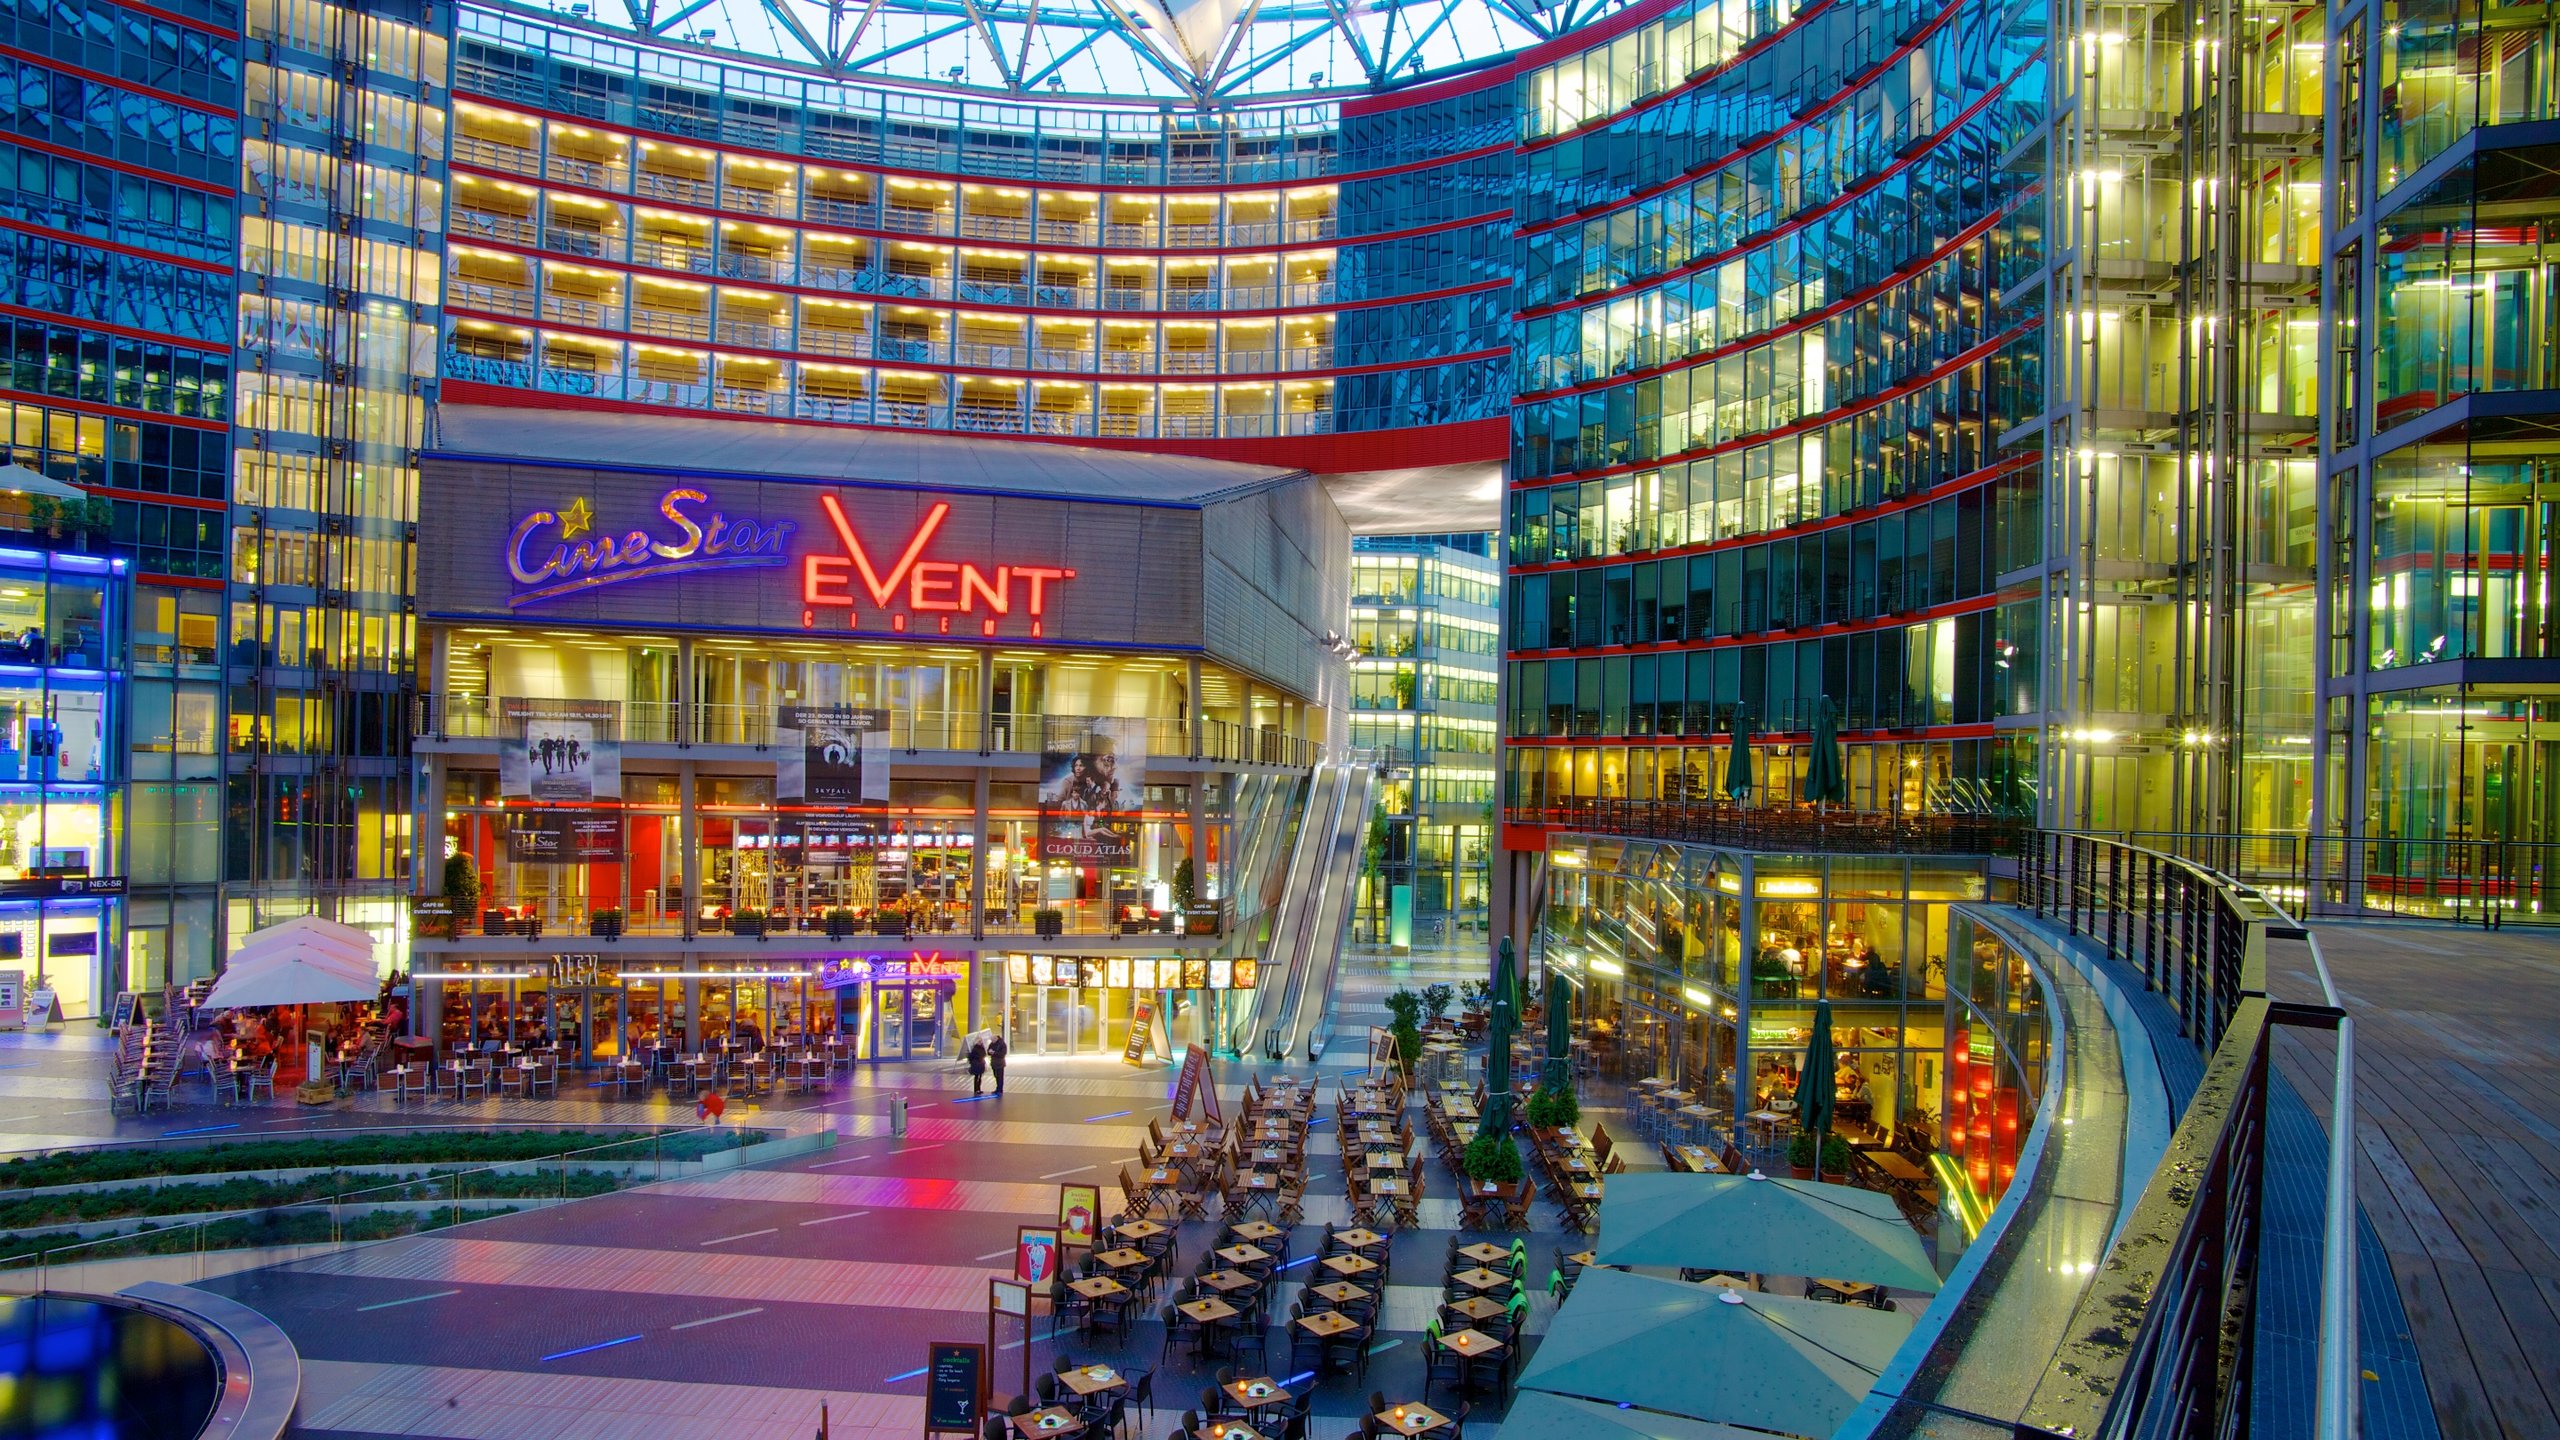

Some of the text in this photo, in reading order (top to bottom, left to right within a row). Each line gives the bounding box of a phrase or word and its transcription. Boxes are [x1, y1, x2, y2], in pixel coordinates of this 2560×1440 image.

[508, 489, 796, 584] CineStar
[805, 495, 1063, 616] EVENT
[803, 610, 1041, 638] CINEMA
[1046, 844, 1132, 856] CLOUD ATLAS
[89, 880, 122, 888] NEX-5R
[551, 954, 599, 987] ALEX
[910, 951, 960, 975] EVENT
